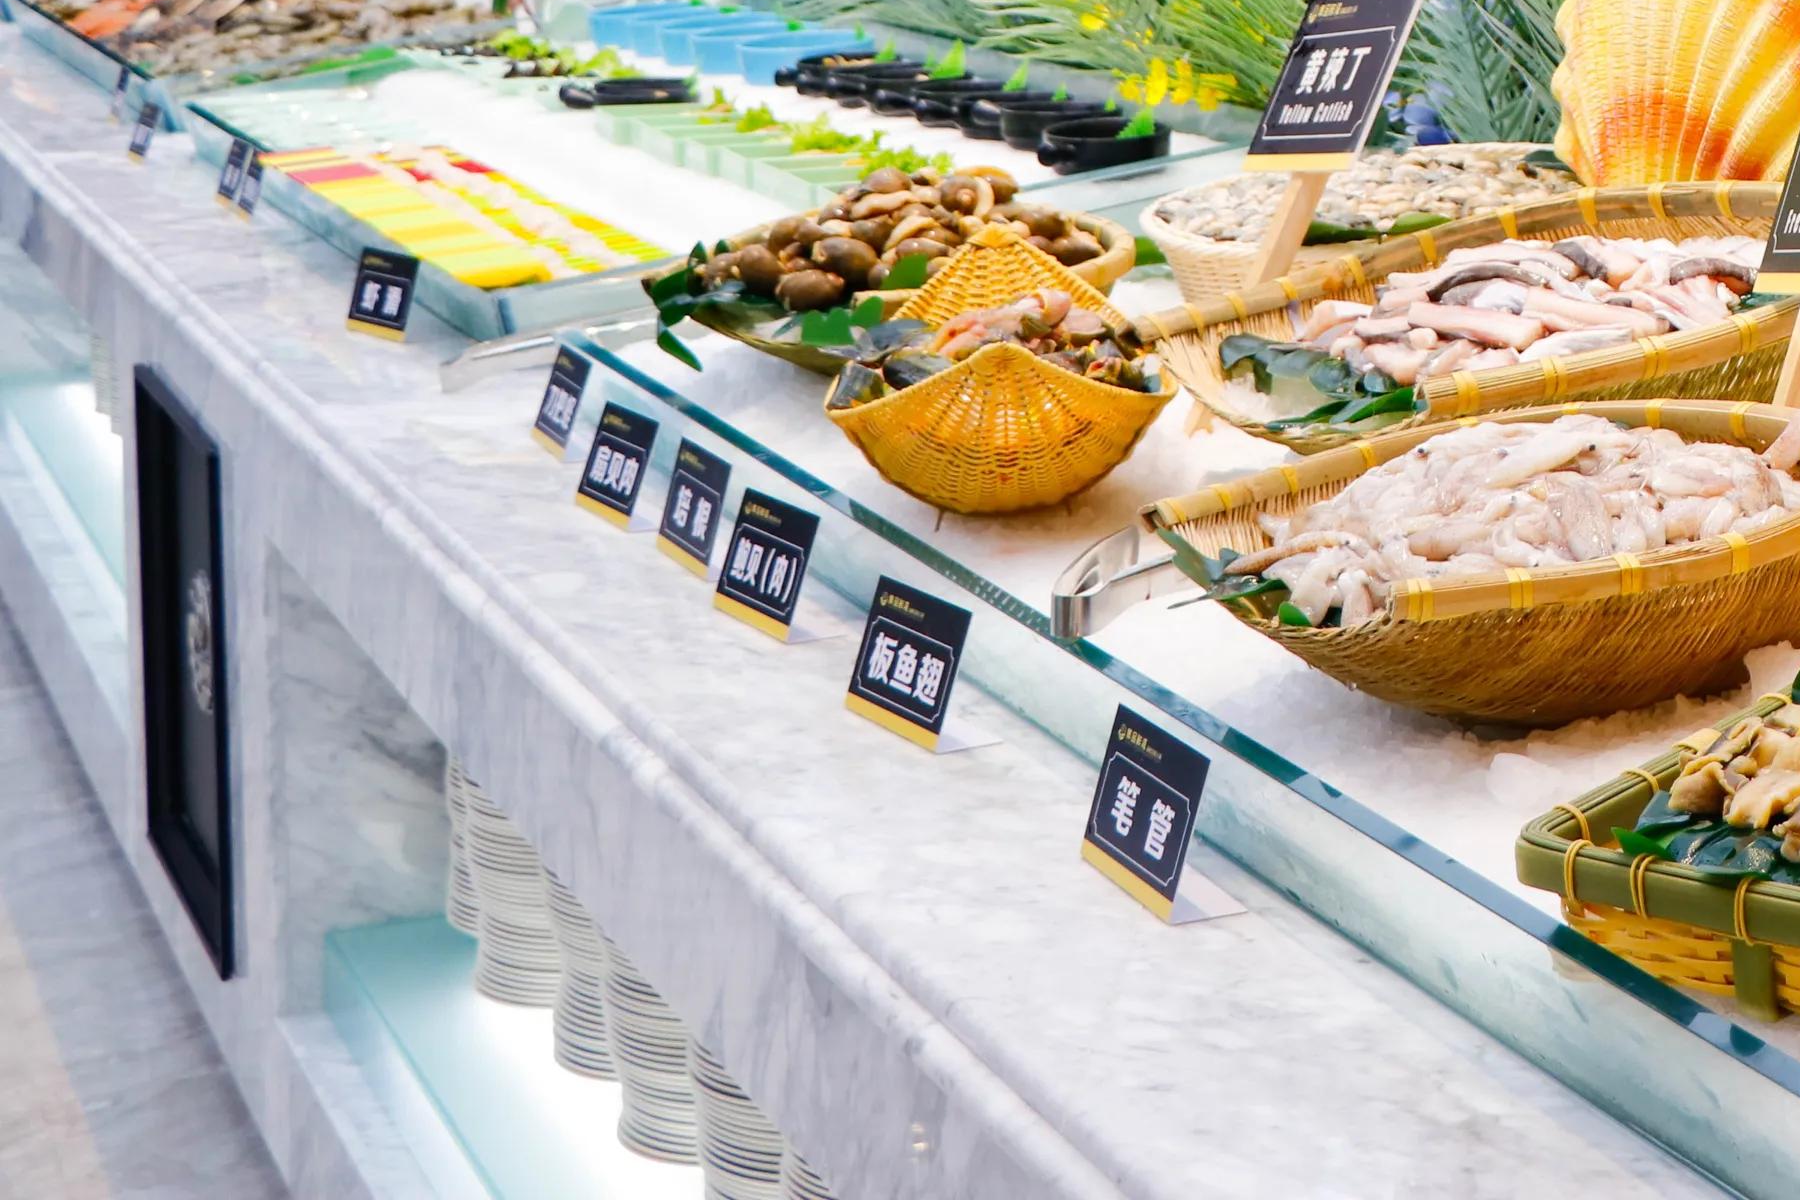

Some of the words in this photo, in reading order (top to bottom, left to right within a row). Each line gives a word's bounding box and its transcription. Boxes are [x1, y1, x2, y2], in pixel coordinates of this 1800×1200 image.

[1295, 46, 1373, 95] 黄辣丁
[1278, 103, 1315, 124] Yellow
[868, 631, 946, 707] 板鱼翅
[1111, 775, 1176, 861] 笔管
